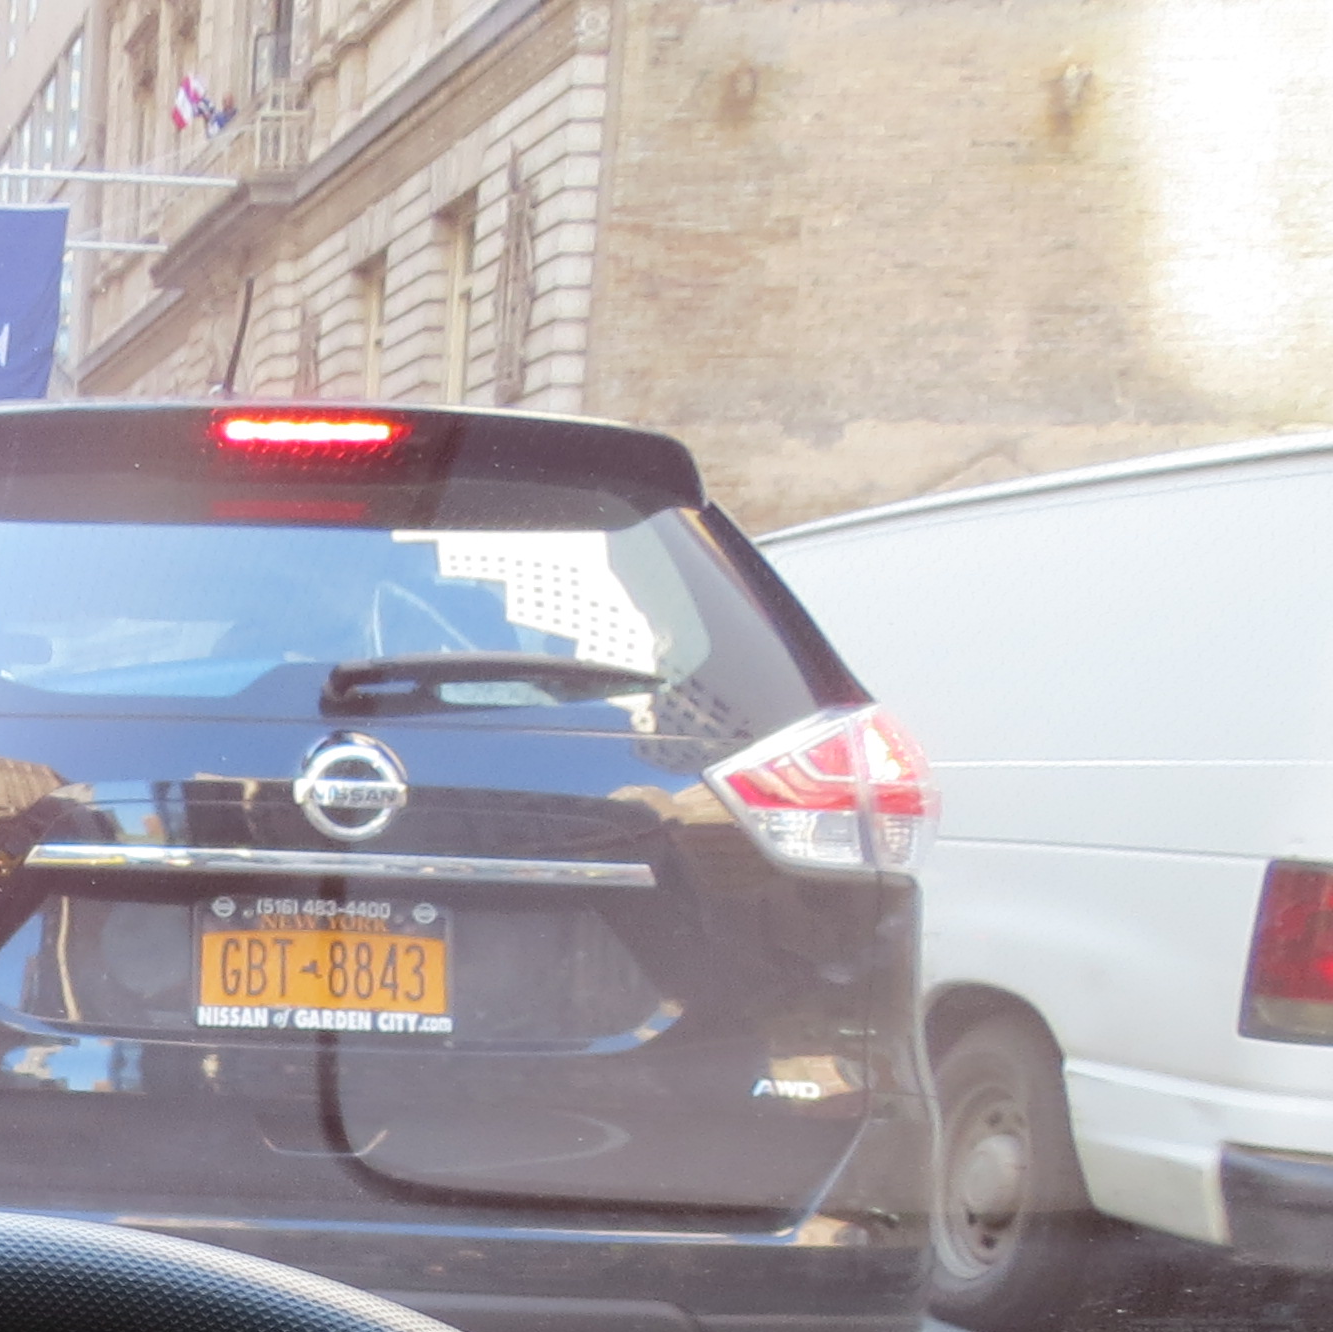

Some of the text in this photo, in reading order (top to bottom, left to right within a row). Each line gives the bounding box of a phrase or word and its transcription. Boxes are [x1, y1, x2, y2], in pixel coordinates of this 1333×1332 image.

[220, 937, 427, 1003] GBT 8843
[197, 1005, 454, 1034] NISSAN of GARDEN CITY.com
[752, 1078, 821, 1100] AWD
